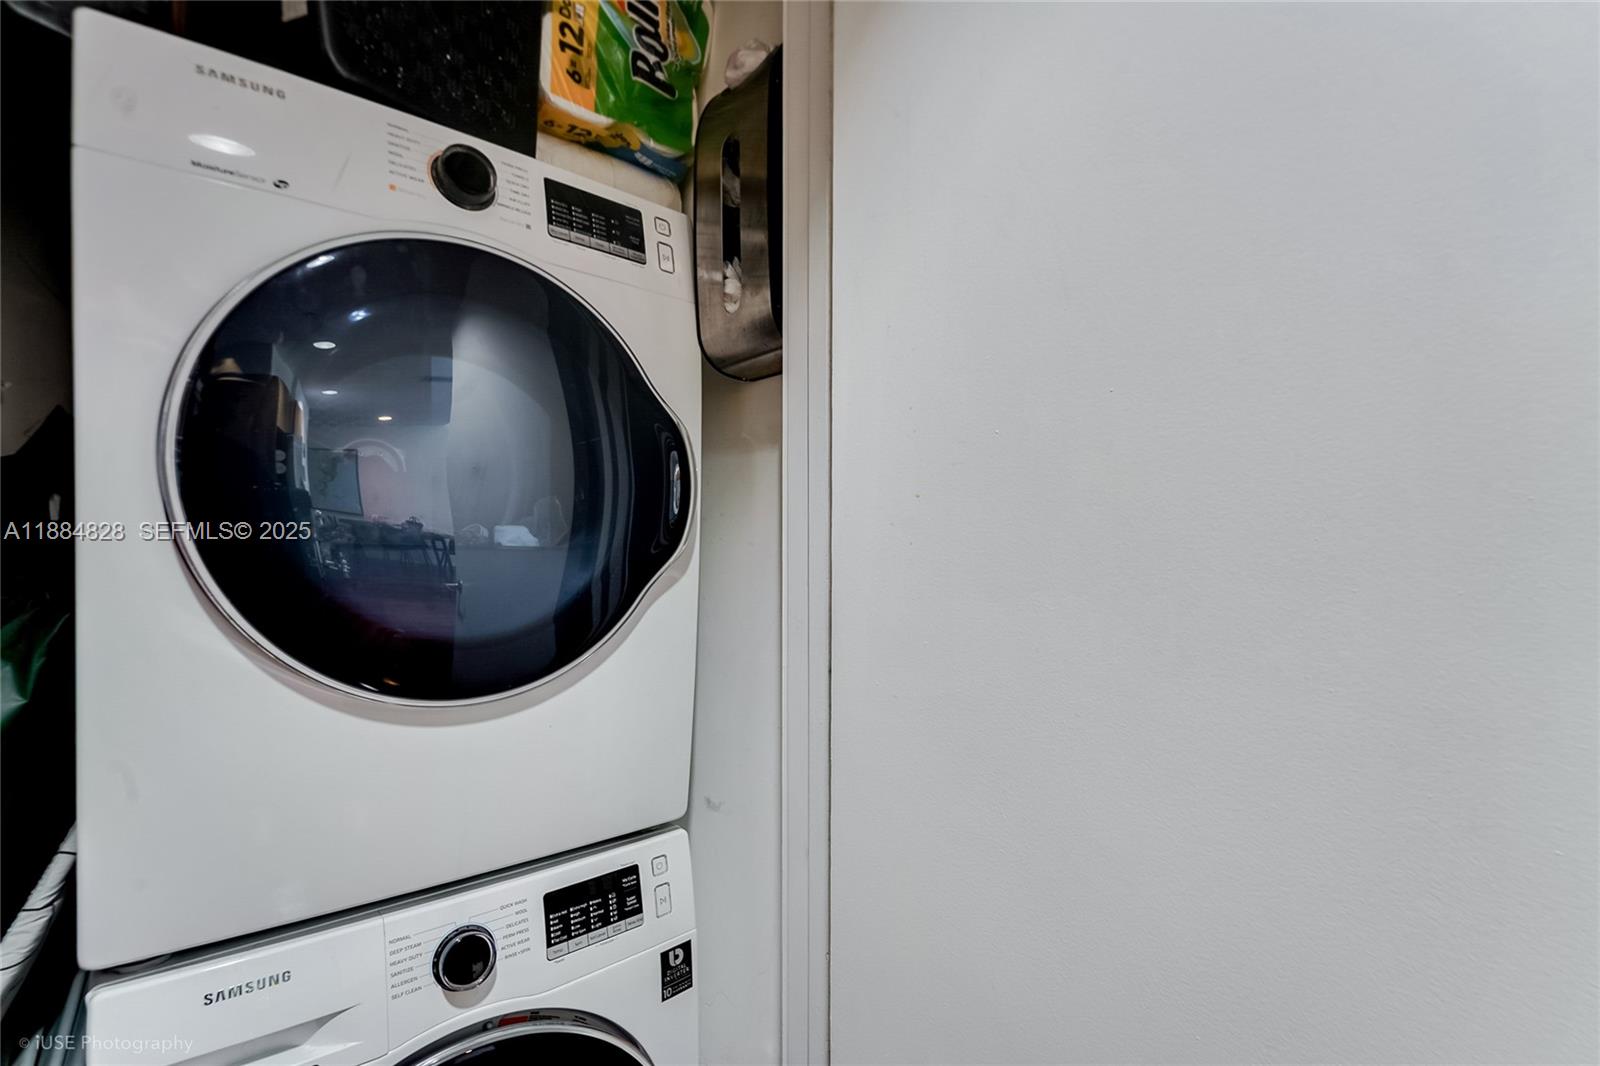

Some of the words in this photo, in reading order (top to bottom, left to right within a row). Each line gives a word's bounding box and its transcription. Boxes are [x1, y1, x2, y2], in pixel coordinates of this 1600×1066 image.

[195, 64, 287, 100] SAMSUNG
[505, 917, 529, 929] DELICATES
[389, 934, 412, 944] NORMAL
[503, 932, 516, 940] PERM
[516, 927, 530, 935] PRESS
[389, 948, 404, 957] DEEP
[404, 941, 423, 952] STEAM
[501, 942, 516, 951] ACTIVE
[517, 937, 531, 945] WEAR
[389, 957, 408, 967] HEAVY
[408, 953, 423, 961] DUTY
[390, 966, 415, 978] SANITIZE
[203, 970, 293, 1006] SAMSUNG
[390, 976, 419, 990] ALLERGEN
[391, 991, 405, 1001] SELF
[405, 986, 423, 995] CLEAN
[663, 987, 673, 999] 10
